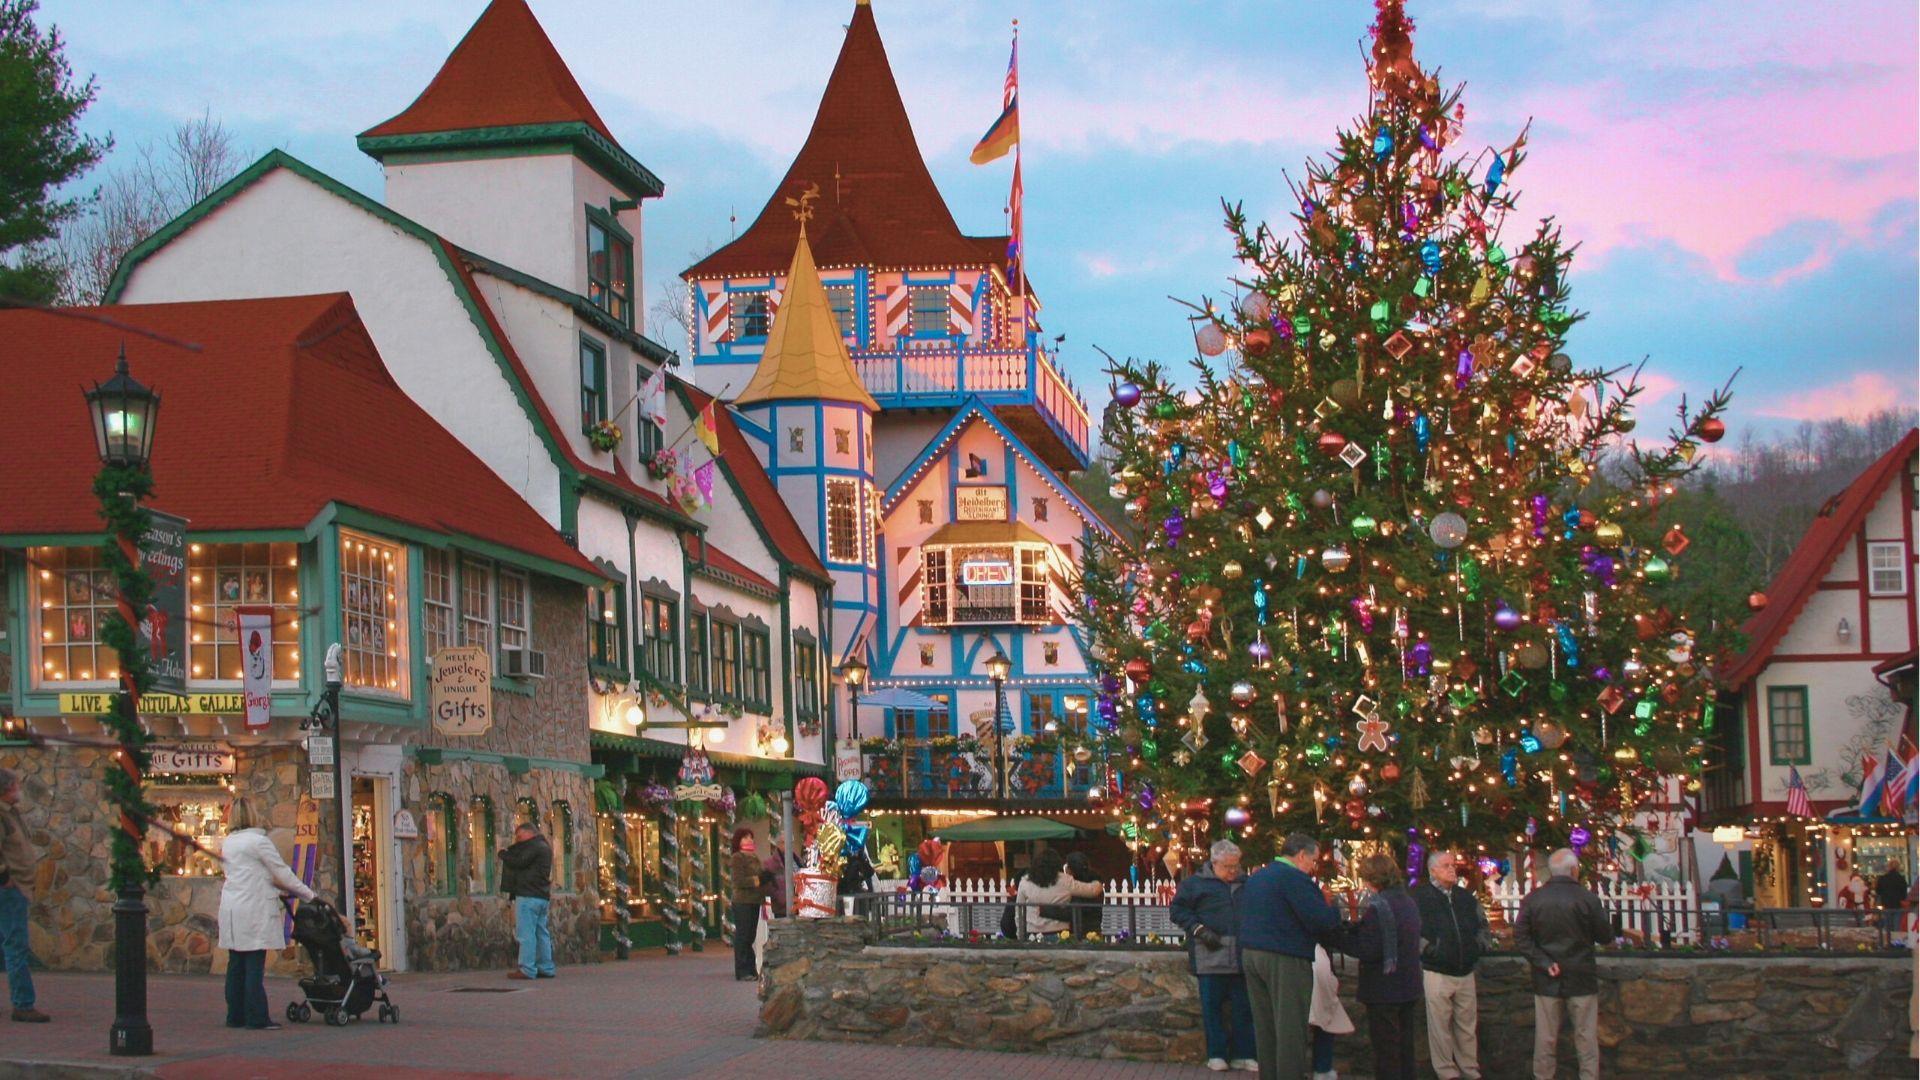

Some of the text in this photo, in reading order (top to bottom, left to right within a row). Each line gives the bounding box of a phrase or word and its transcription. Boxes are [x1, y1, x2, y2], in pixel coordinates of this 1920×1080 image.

[959, 497, 1006, 510] Heidelberg
[141, 527, 182, 547] eason's
[137, 548, 184, 576] reetings
[966, 565, 1010, 582] OPEN
[445, 654, 475, 662] HELEN
[435, 662, 487, 683] Jewelers
[71, 695, 246, 712] LIVE NTULAS GALLER
[438, 697, 486, 727] Gifts
